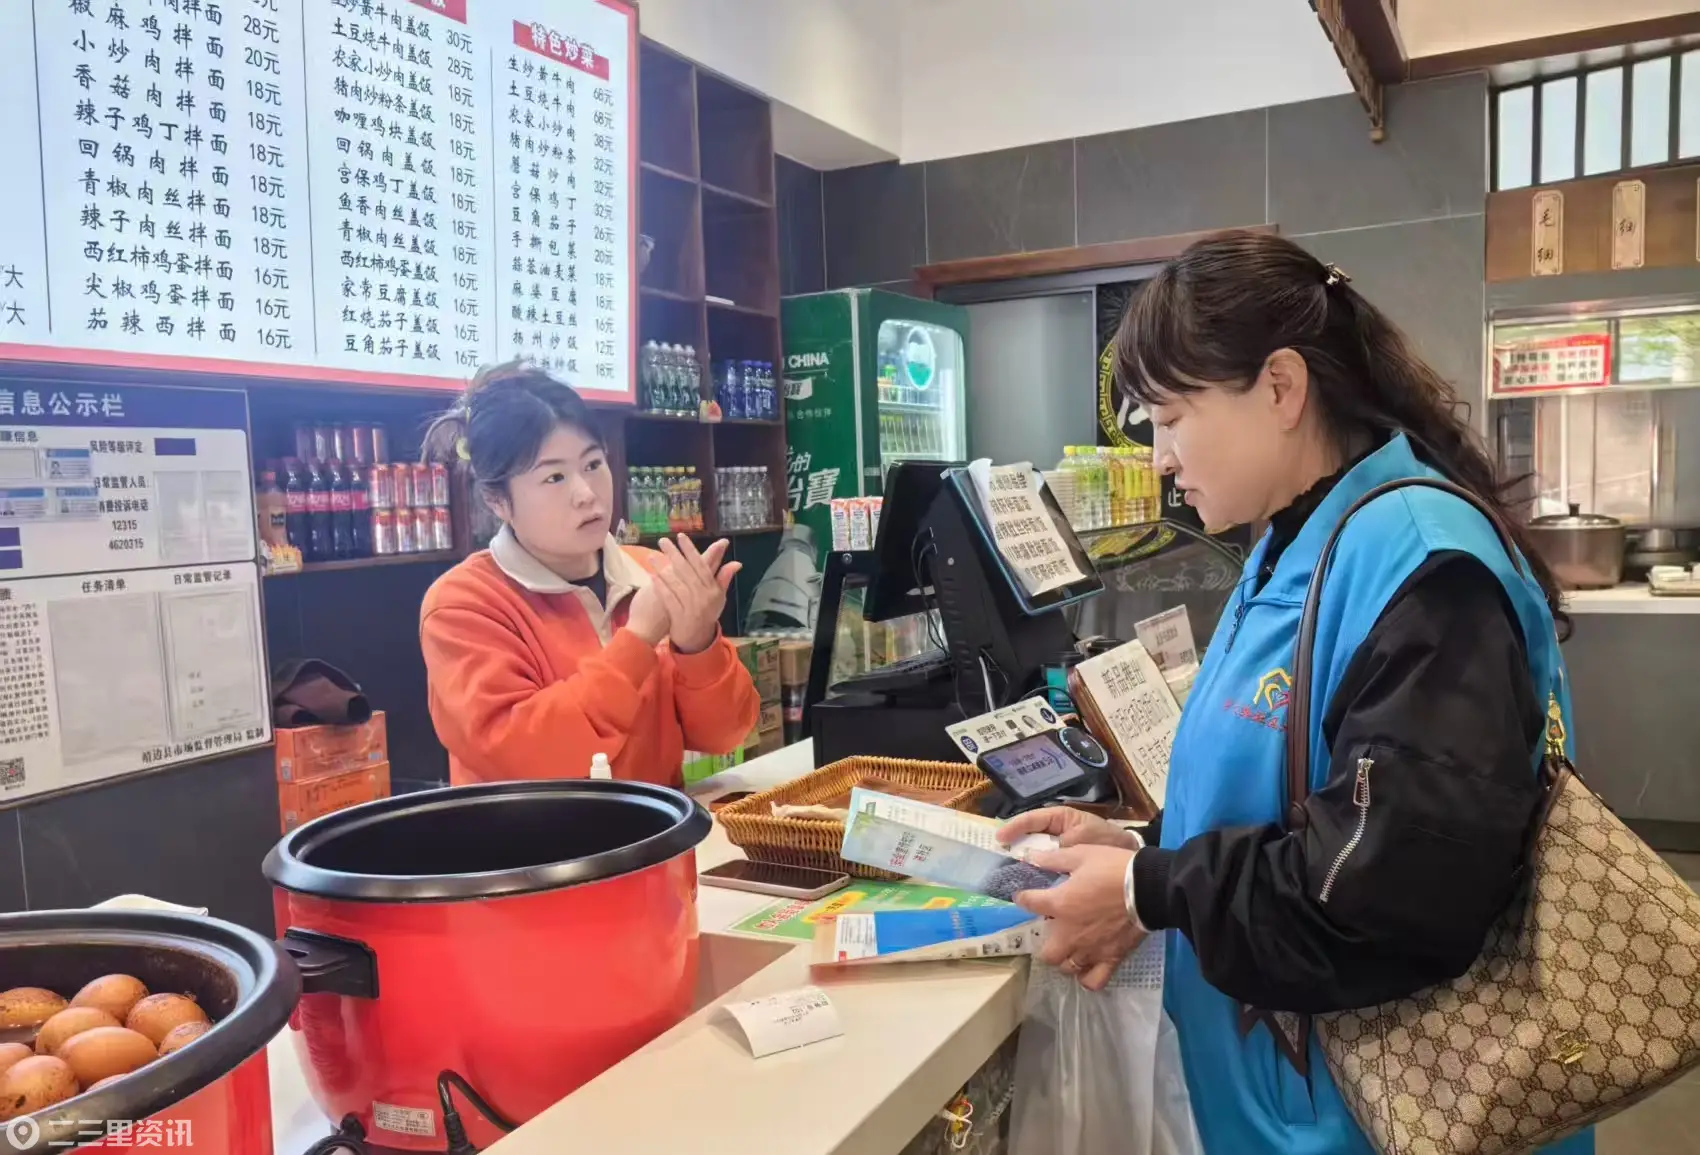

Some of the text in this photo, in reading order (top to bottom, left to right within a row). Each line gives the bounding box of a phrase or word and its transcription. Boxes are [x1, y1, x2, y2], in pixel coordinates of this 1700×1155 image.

[243, 16, 279, 44] 28元
[332, 18, 474, 81] 土豆烧牛肉盖饭 28元
[446, 29, 473, 54] 30元
[530, 22, 596, 69] 特色炒菜
[73, 30, 282, 107] 小炒肉拌面 18元
[245, 47, 280, 75] 20元
[332, 46, 475, 108] 农家小炒肉盖饭 18元
[73, 64, 283, 137] 香菇肉拌面 18元
[334, 77, 475, 135] 猪肉炒粉条盖饭 18元
[508, 80, 614, 130] 土豆烧牛肉 68元
[593, 87, 614, 106] 68元
[75, 99, 284, 168] 辣子鸡丁拌面 18元
[335, 106, 476, 162] 咖喱鸡块盖饭 18元
[508, 104, 614, 152] 农家小炒肉 38元
[79, 139, 285, 199] 回锅肉拌面 18元
[336, 137, 476, 189] 回锅肉盖饭 18元
[594, 156, 614, 176] 32元
[78, 168, 287, 229] 青椒肉丝拌面 18元
[338, 163, 477, 215] 宫保鸡丁盖饭 18元
[511, 180, 614, 221] 宫保鸡丁 32元
[594, 180, 614, 198] 32元
[80, 203, 288, 259] 辣子肉丝拌面 18元
[338, 192, 478, 241] 鱼香肉丝盖饭 18元
[512, 206, 615, 244] 豆角茄子 26元
[338, 219, 478, 266] 青椒肉丝盖饭 18元
[594, 248, 615, 266] 20元
[84, 241, 289, 290] 西红柿鸡蛋拌面 16元
[340, 249, 479, 292] 西红柿鸡蛋盖饭 16元
[596, 272, 615, 288] 18元
[84, 273, 290, 320] 尖椒鸡蛋拌面 16元
[340, 275, 479, 318] 家常豆腐盖饭 16元
[596, 295, 615, 312] 18元
[87, 307, 292, 350] 茄辣西拌面 16元
[341, 304, 480, 343] 红烧茄子盖饭 16元
[596, 317, 615, 334] 16元
[344, 334, 480, 368] 豆角茄子盖饭 16元
[596, 340, 615, 357] 12元
[788, 352, 830, 368] CHINA
[596, 362, 615, 380] 18元
[0, 390, 126, 418] 信息公示栏
[90, 440, 144, 454] 风险等级评定
[109, 538, 144, 550] 4620315
[112, 520, 138, 531] 12315
[82, 578, 126, 594] 任务清单
[174, 569, 232, 585] 日常监管记录
